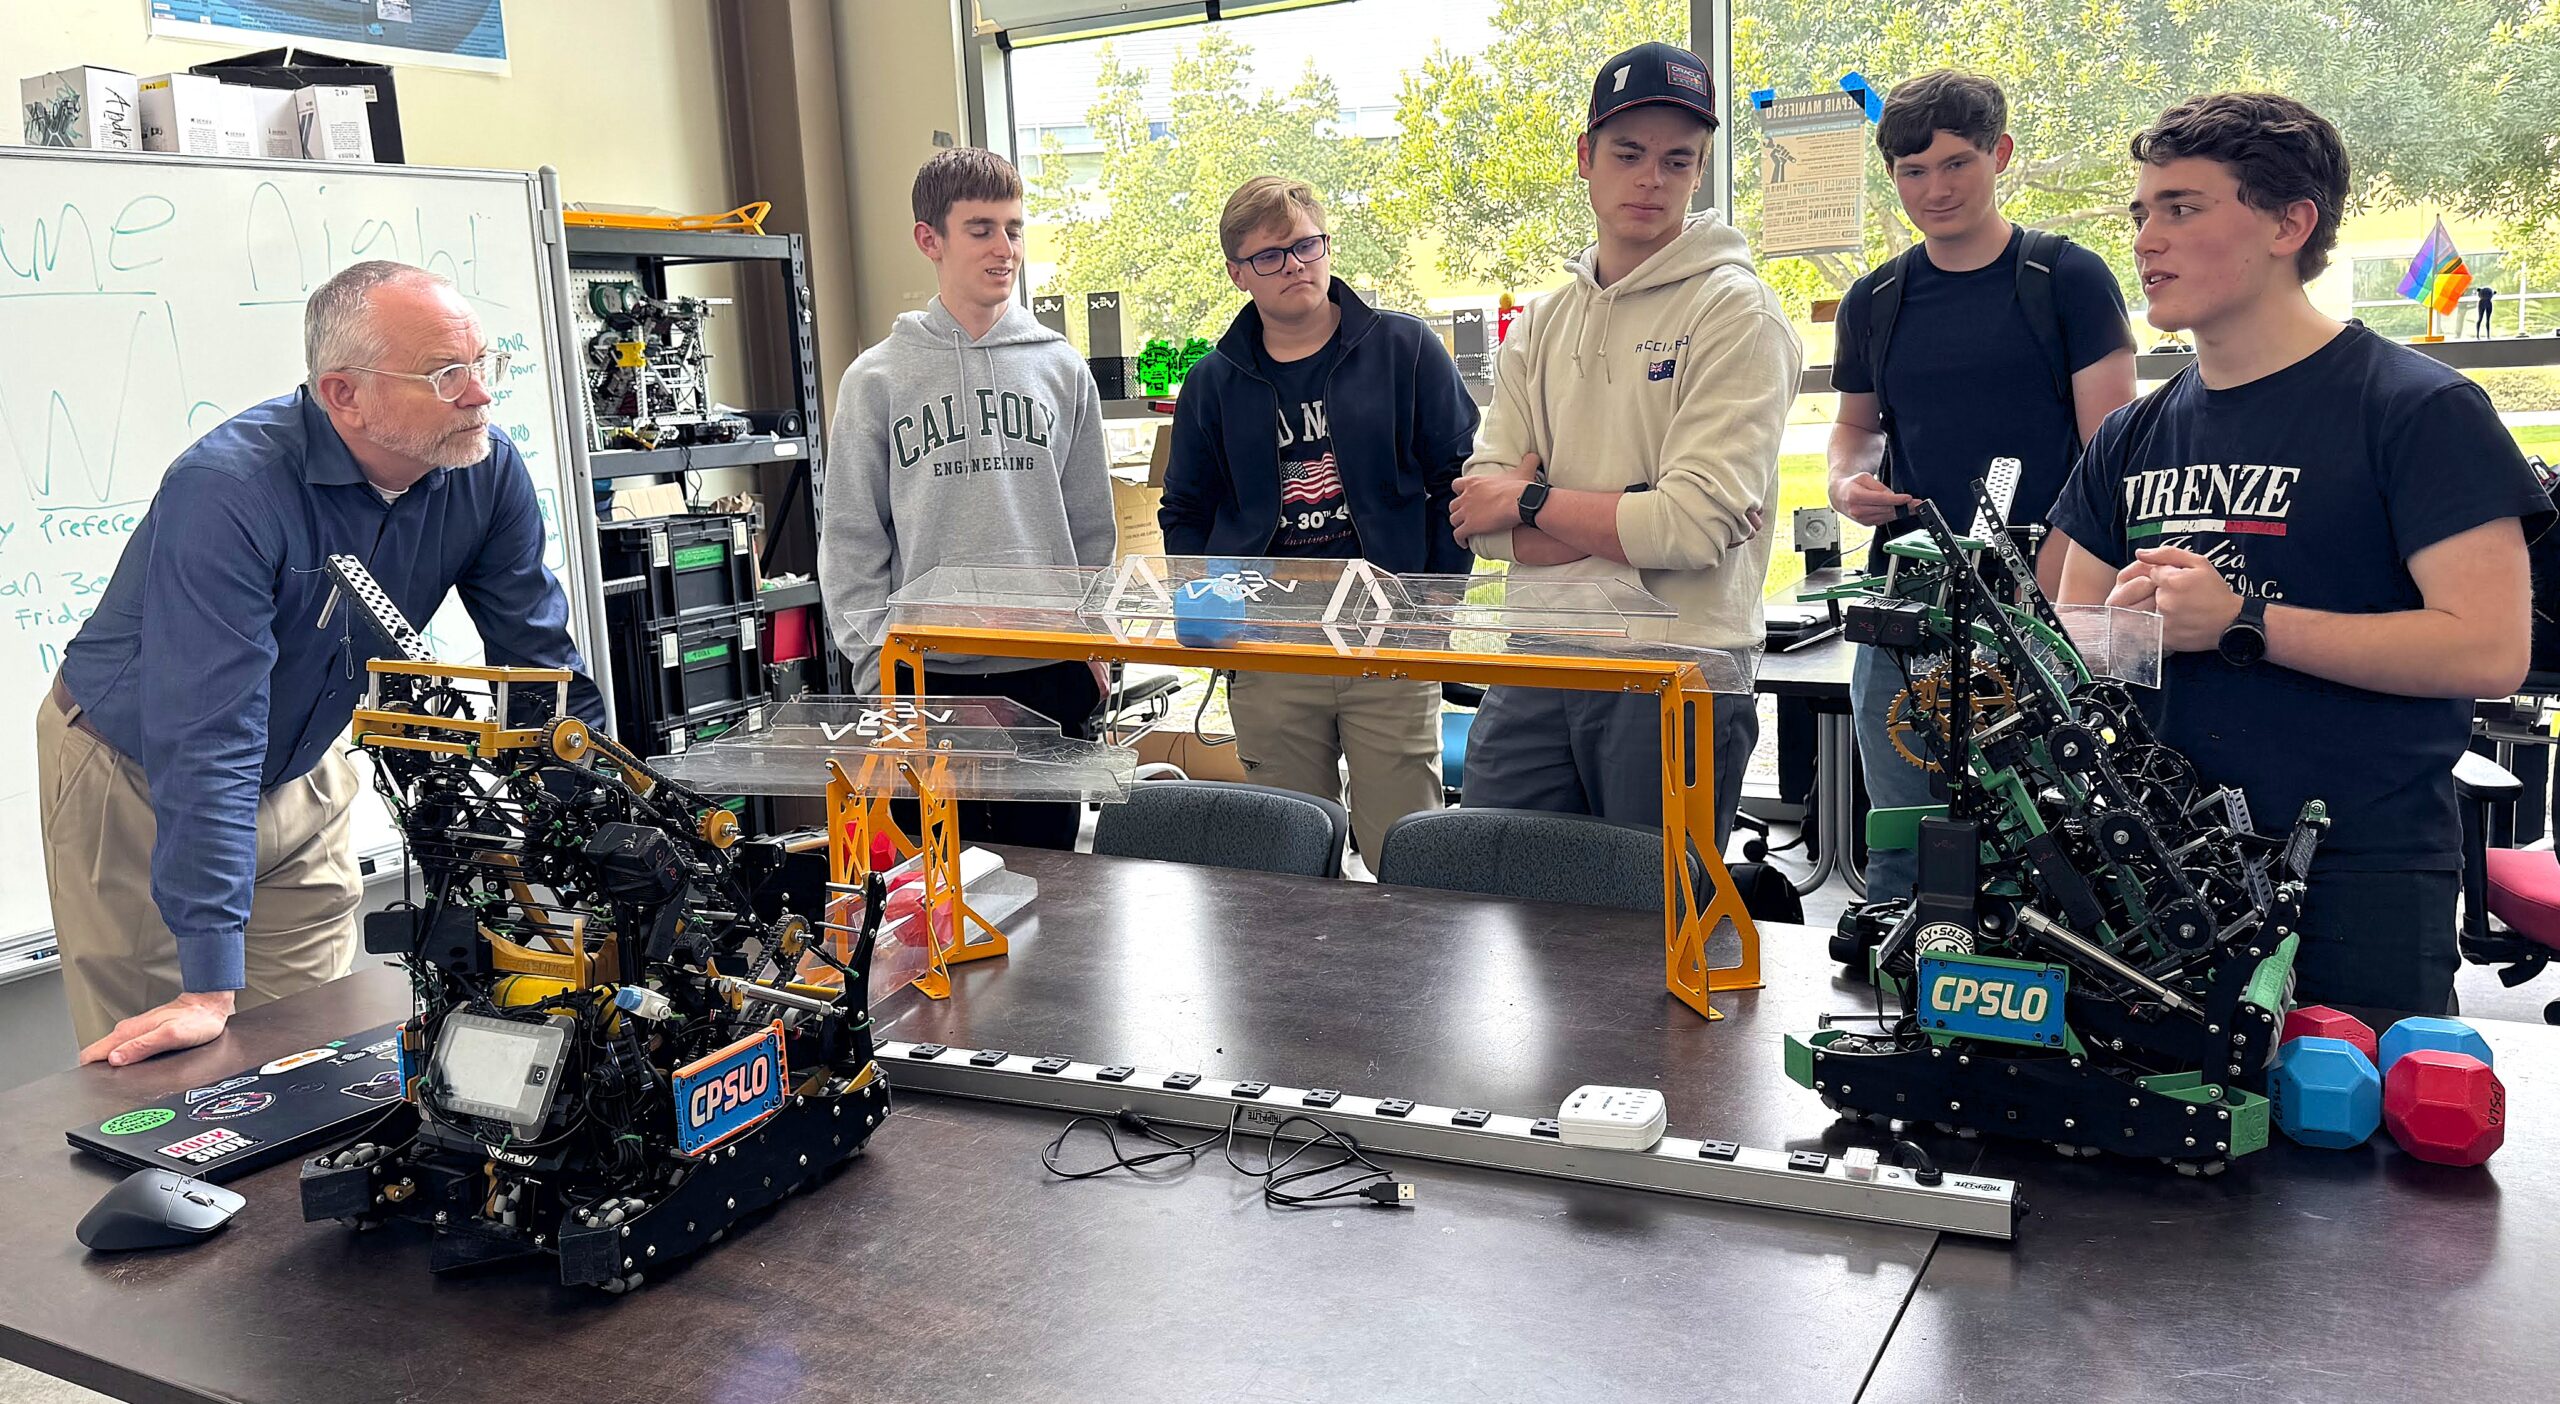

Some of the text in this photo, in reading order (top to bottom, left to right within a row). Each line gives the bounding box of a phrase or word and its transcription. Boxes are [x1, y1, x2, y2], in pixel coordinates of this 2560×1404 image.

[1613, 64, 1632, 93] 1
[892, 393, 970, 469] CAL
[1931, 975, 2049, 1023] CPSLO
[690, 1055, 769, 1128] CPSLO
[166, 1130, 231, 1156] ROCK
[186, 1136, 254, 1163] SHOX
